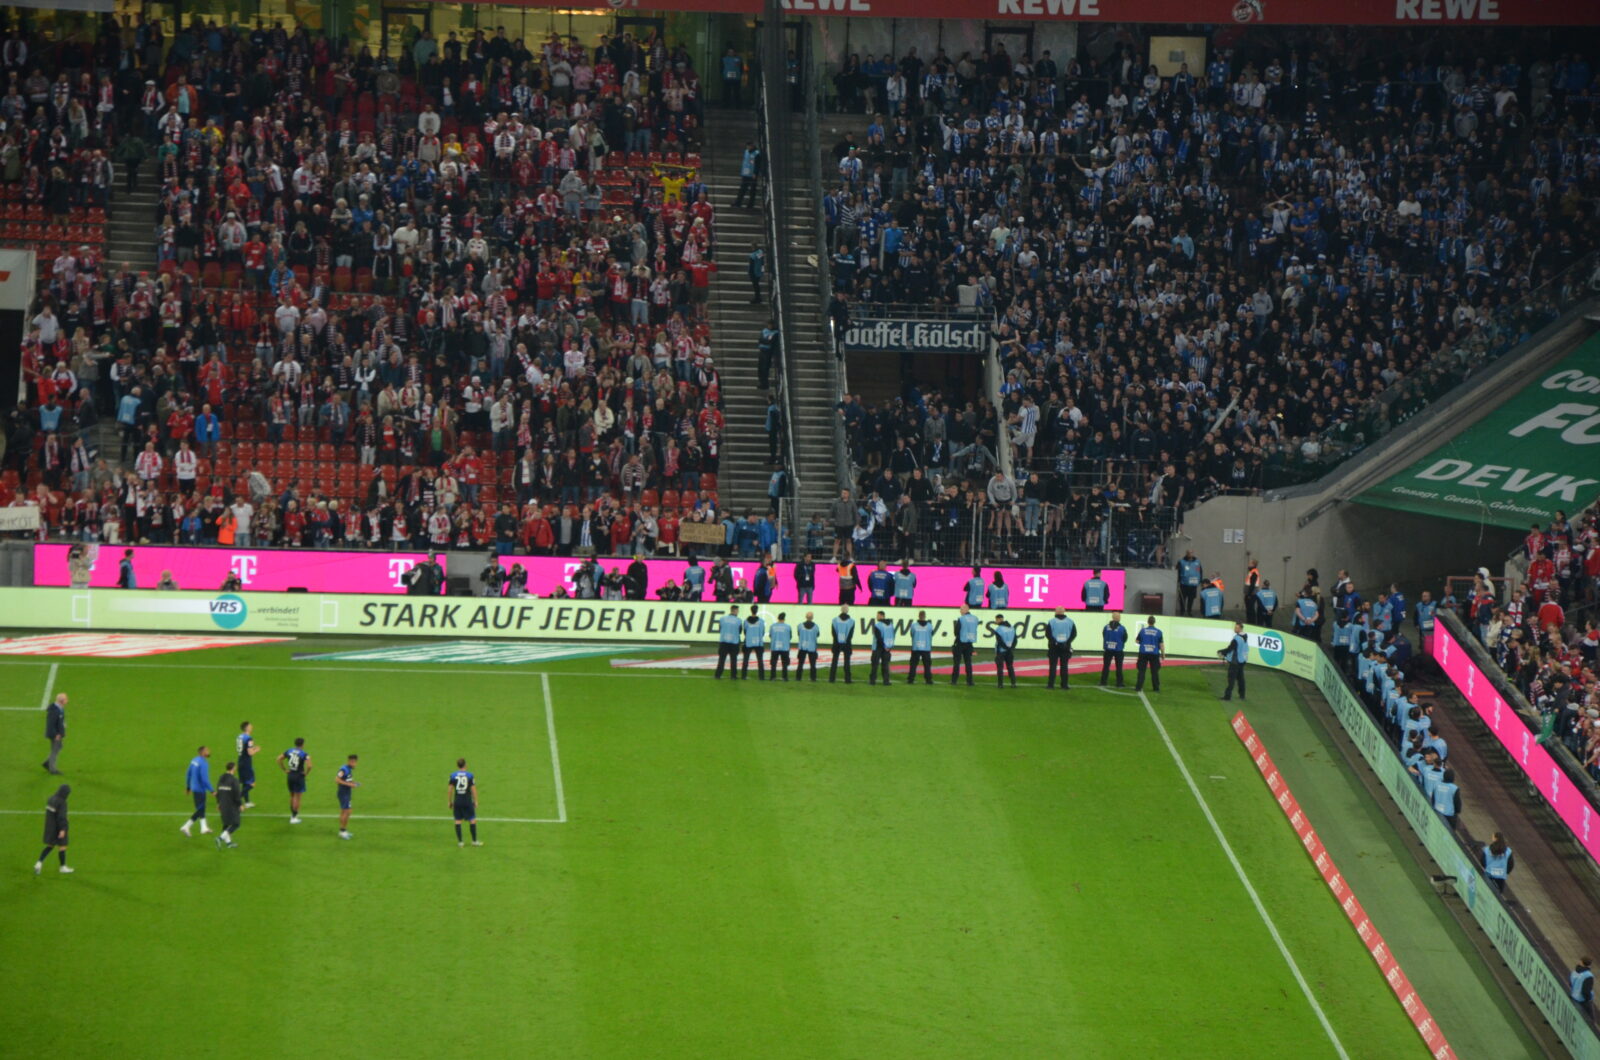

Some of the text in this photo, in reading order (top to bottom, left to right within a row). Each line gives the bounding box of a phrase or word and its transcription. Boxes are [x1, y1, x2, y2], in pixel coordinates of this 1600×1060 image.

[1396, 0, 1500, 19] REWE
[1542, 369, 1600, 394] Co
[1414, 458, 1599, 502] DEVK
[1024, 574, 1049, 602] T
[209, 601, 237, 613] VRS
[359, 602, 461, 628] STARK
[467, 605, 534, 630] AUF
[539, 606, 636, 632] JEDER
[1257, 636, 1279, 651] VRS
